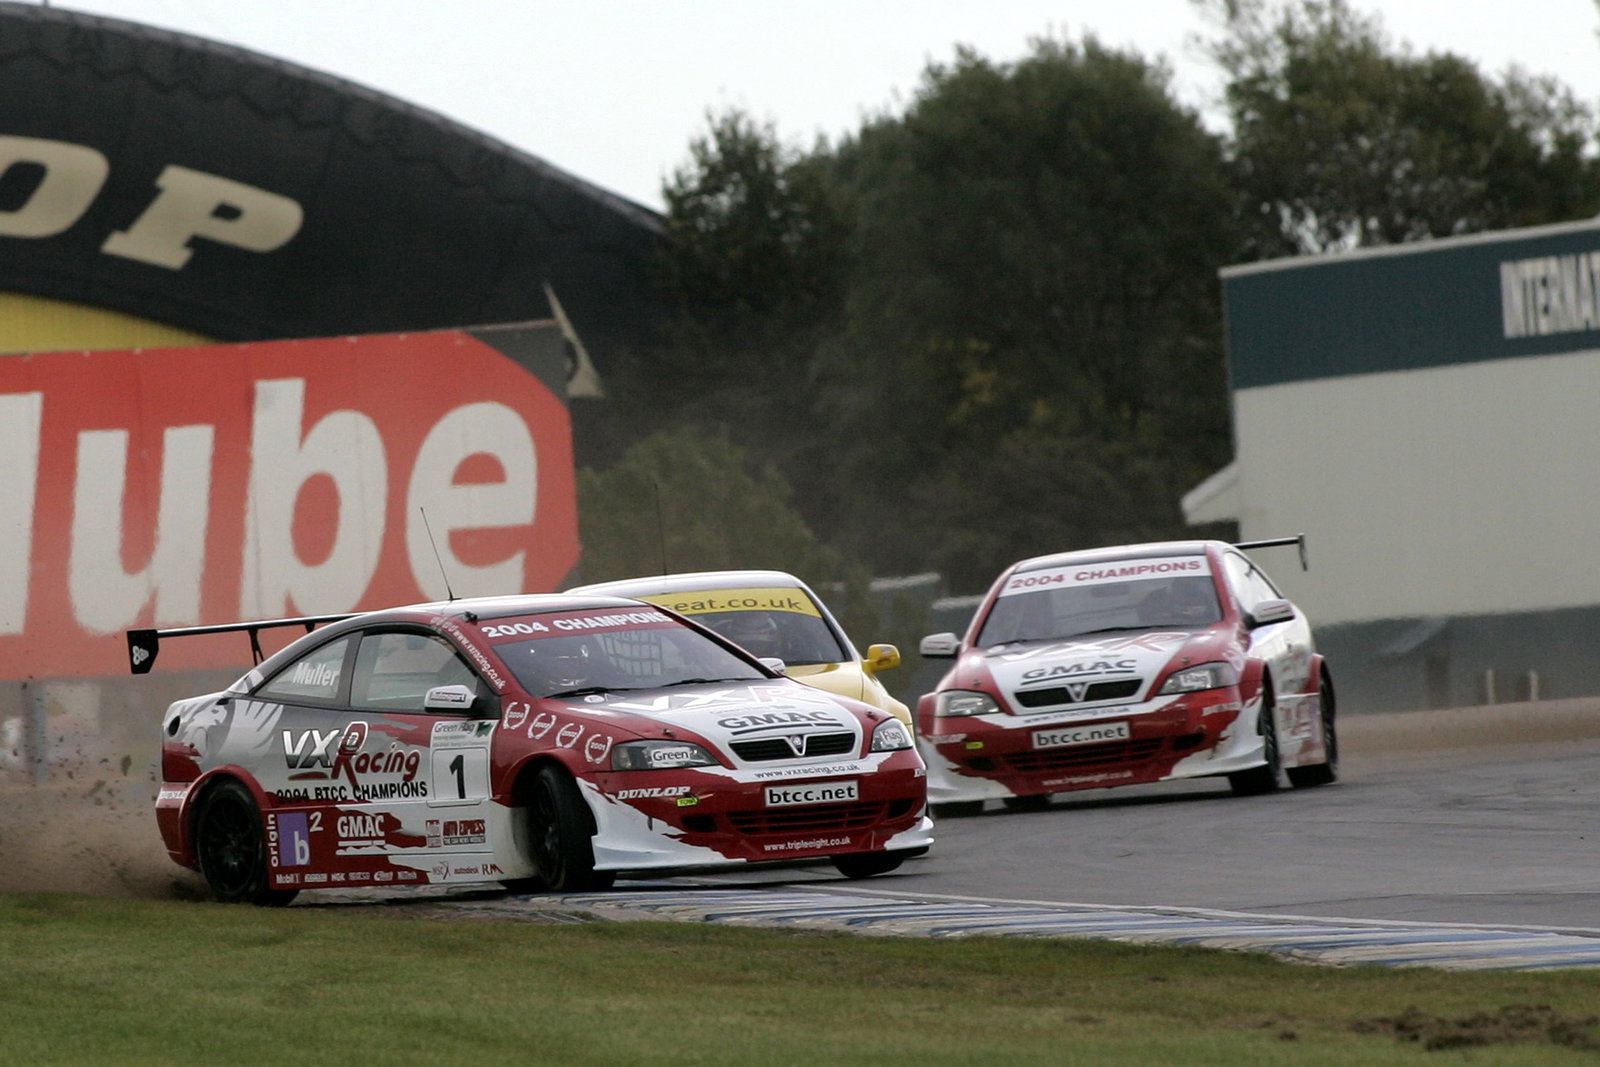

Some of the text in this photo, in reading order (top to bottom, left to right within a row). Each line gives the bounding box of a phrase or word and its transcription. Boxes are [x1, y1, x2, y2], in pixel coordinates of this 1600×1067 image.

[1009, 560, 1202, 590] 2004 CHAMPIONS
[481, 611, 673, 638] 2004 CHAMPIONS
[293, 661, 340, 686] Muller
[1022, 659, 1137, 680] GMAC
[718, 711, 838, 728] GMAC
[1037, 726, 1126, 746] btcc.net
[652, 749, 689, 762] Green
[449, 755, 466, 800] 1
[754, 764, 860, 779] www.vxracing.co.uk
[315, 786, 348, 801] BTCC
[353, 781, 428, 799] CHAMPIONS
[617, 786, 691, 800] DUNLOP
[768, 785, 856, 804] btcc.net
[309, 811, 323, 832] 2
[337, 816, 385, 838] GMAC
[266, 814, 279, 867] origin
